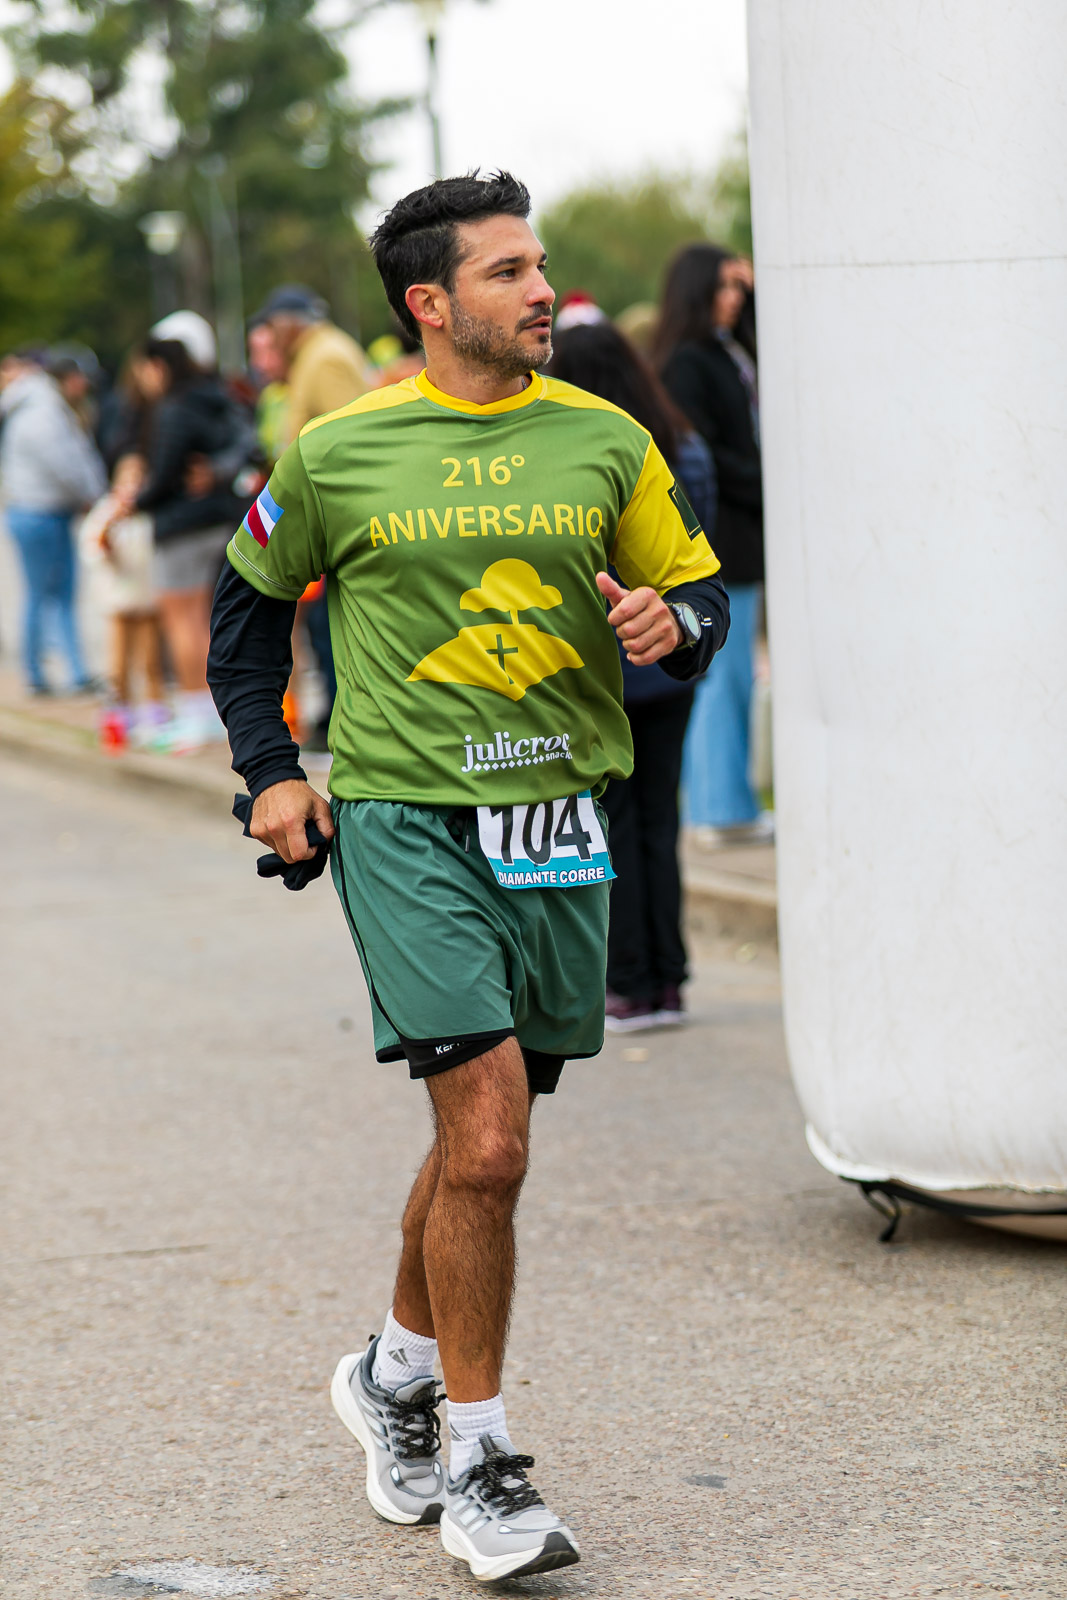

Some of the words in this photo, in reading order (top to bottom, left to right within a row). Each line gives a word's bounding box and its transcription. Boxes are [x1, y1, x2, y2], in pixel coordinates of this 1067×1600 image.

[441, 454, 526, 488] 216°
[369, 503, 603, 547] ANIVERSARIO
[488, 793, 593, 866] 104
[498, 870, 557, 886] DIAMANTE
[559, 866, 606, 884] CORRE
